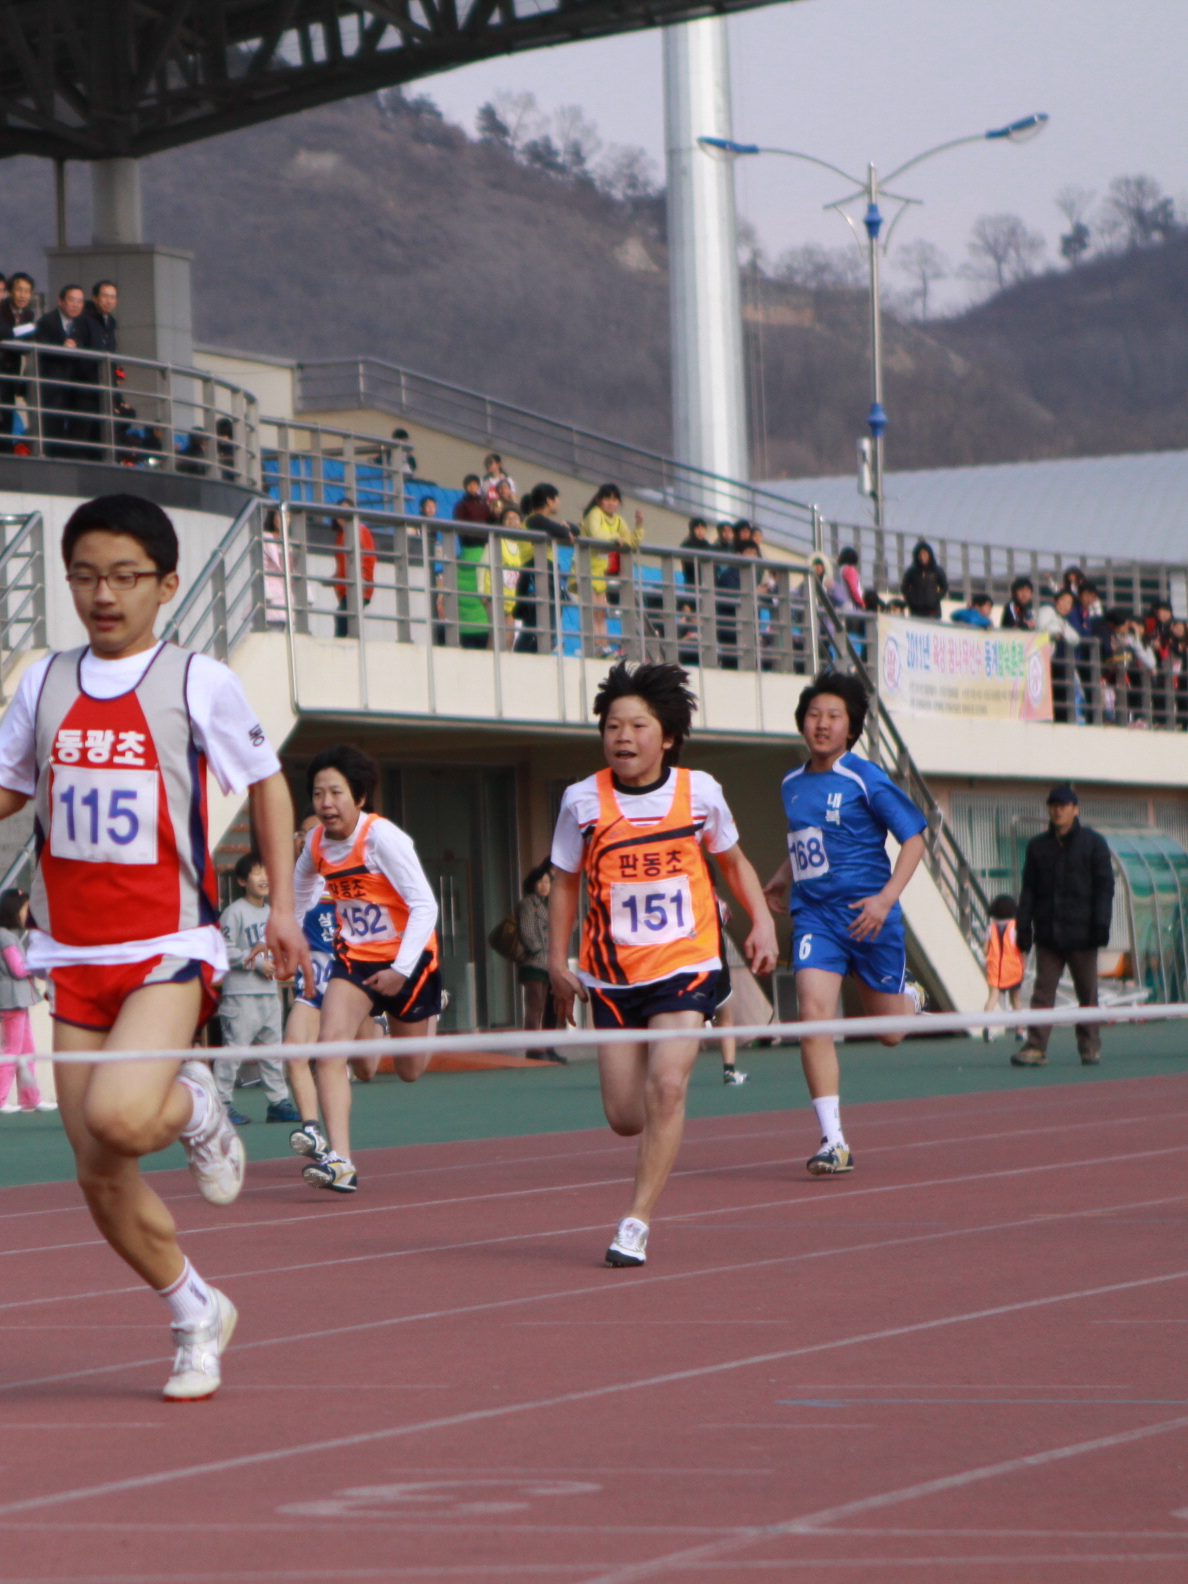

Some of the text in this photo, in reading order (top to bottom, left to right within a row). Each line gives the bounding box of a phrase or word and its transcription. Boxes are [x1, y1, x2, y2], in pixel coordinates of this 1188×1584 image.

[55, 729, 146, 766] 동광초
[59, 785, 139, 845] 115
[619, 850, 682, 878] 판동초
[789, 837, 825, 871] 168
[342, 904, 387, 936] 152
[622, 888, 684, 933] 151
[799, 934, 813, 960] 6
